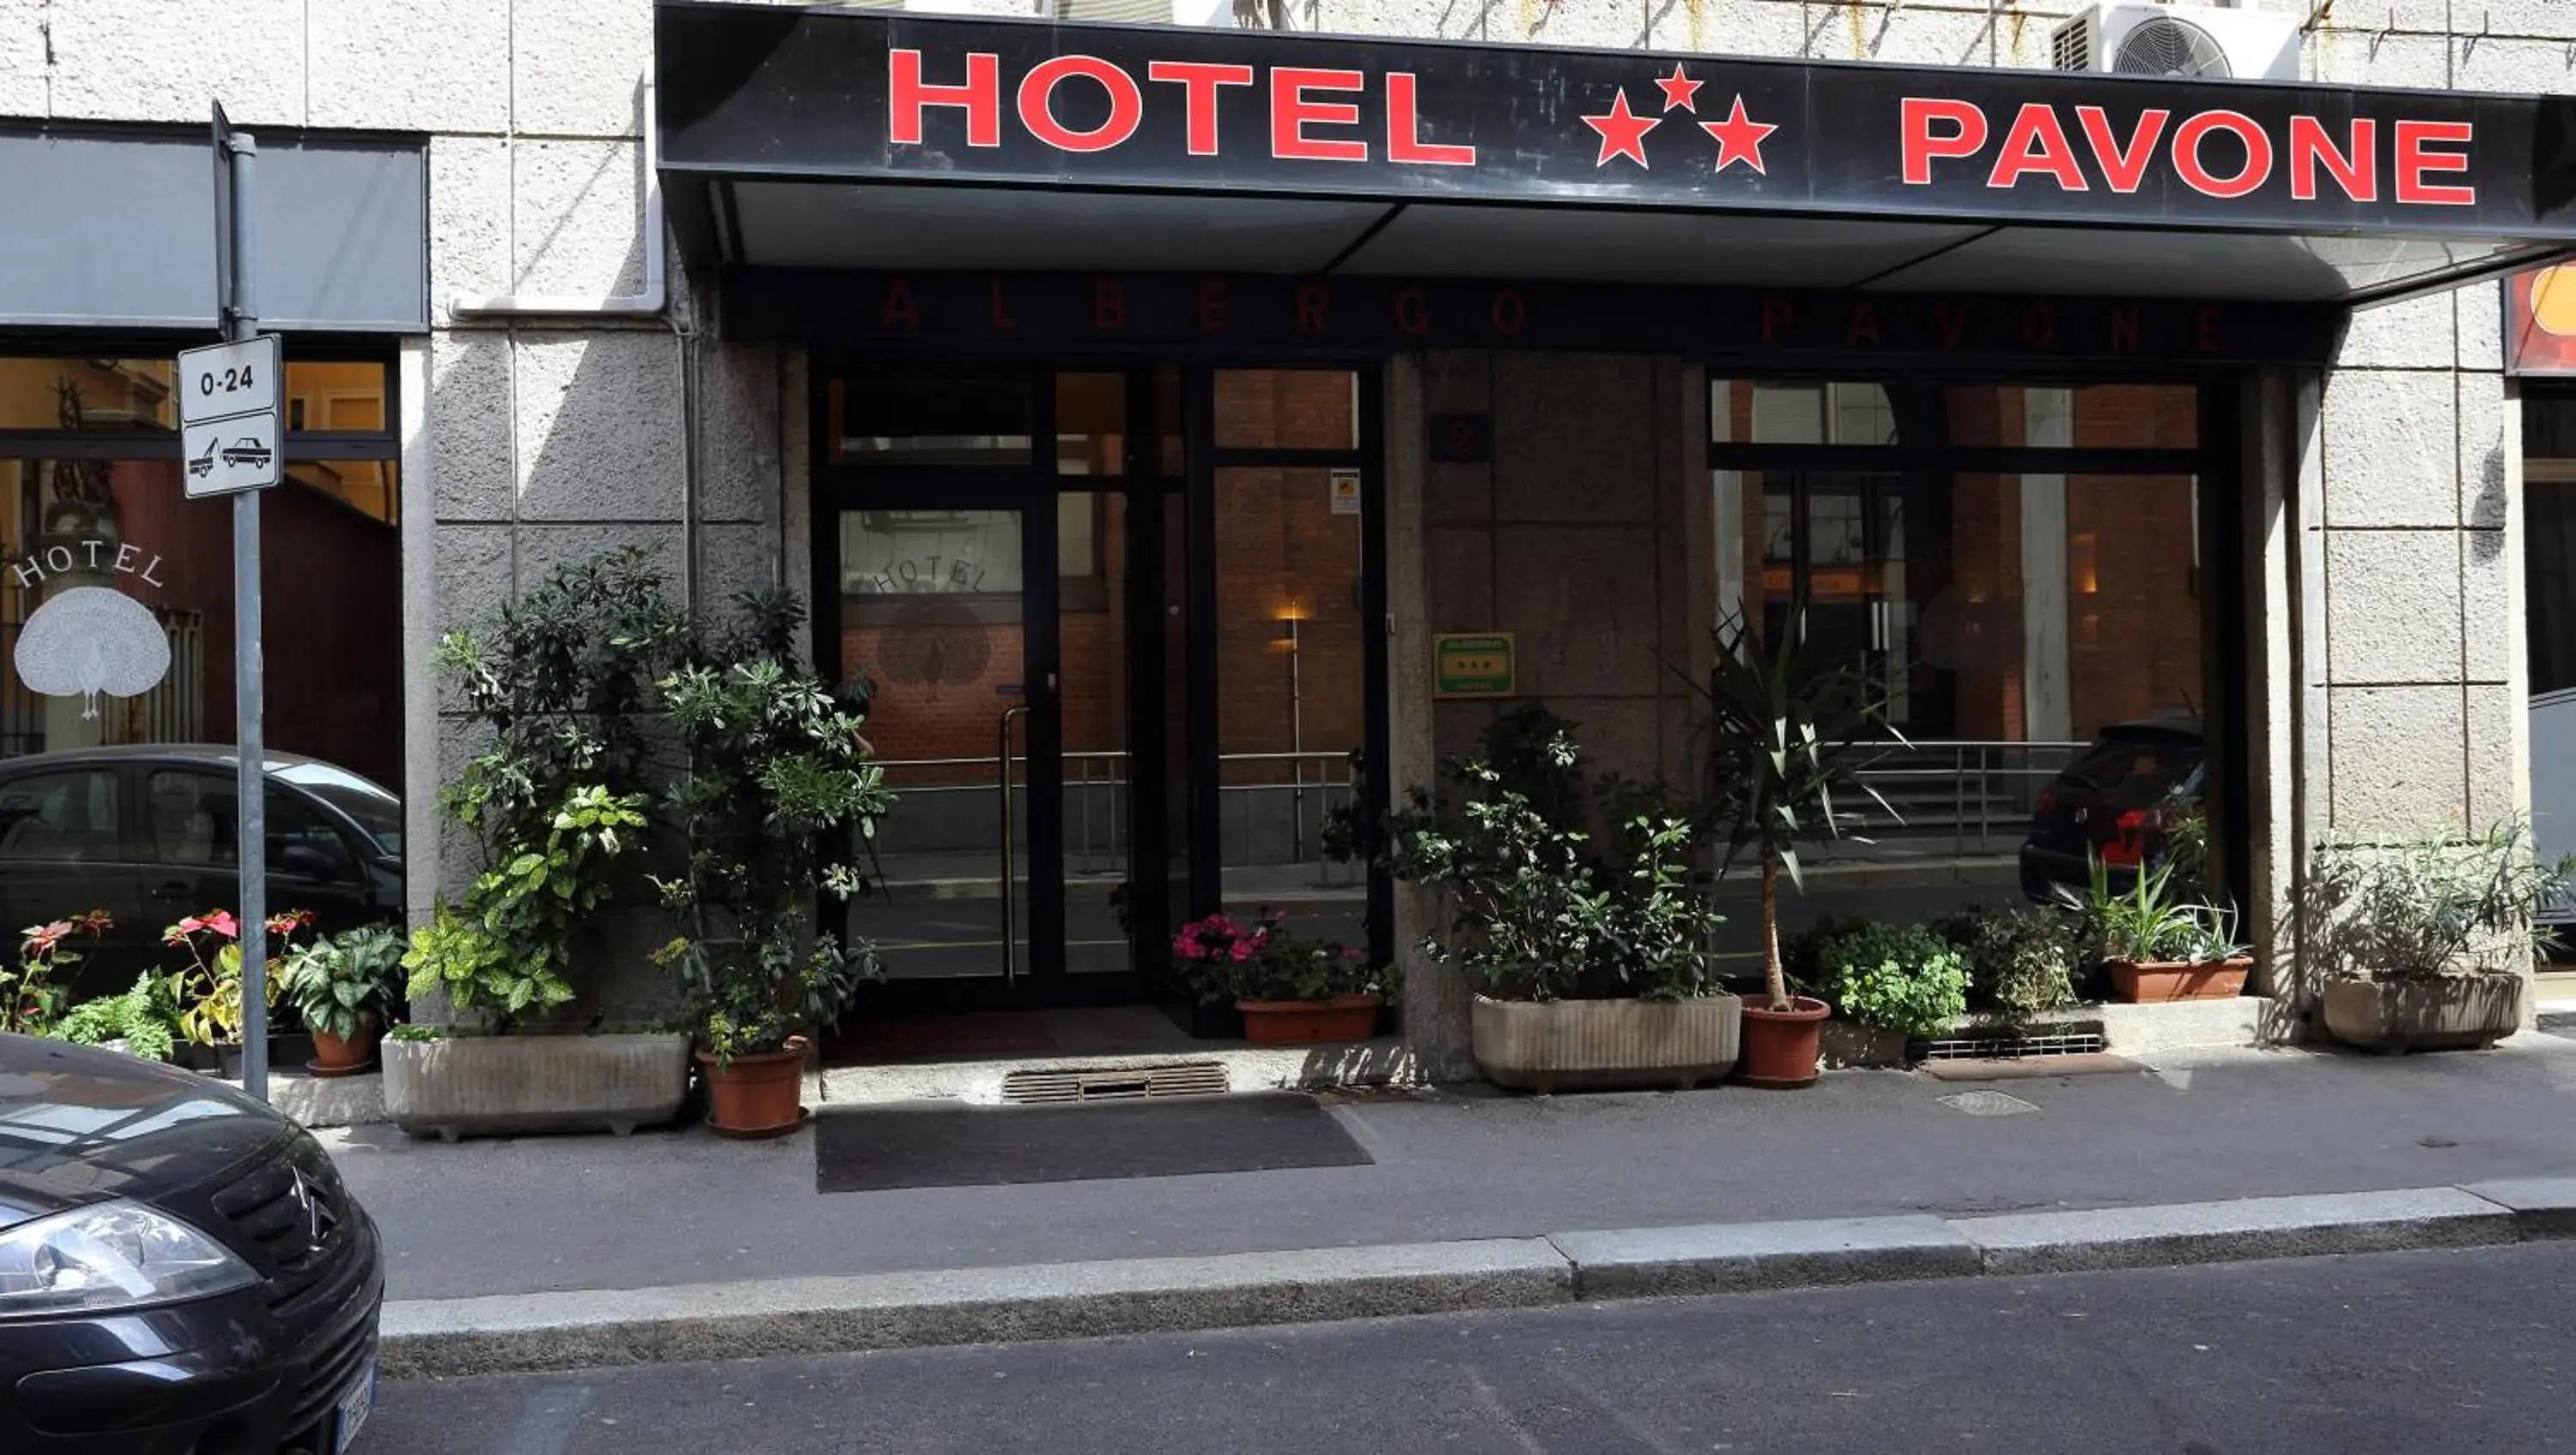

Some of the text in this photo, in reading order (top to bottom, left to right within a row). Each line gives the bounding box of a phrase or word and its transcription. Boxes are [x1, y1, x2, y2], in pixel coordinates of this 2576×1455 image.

[888, 48, 2476, 206] HOTEL PAVONE
[882, 277, 2225, 350] ALBERGO PAVONE
[200, 365, 253, 395] 0-24
[11, 540, 164, 588] HOTEL
